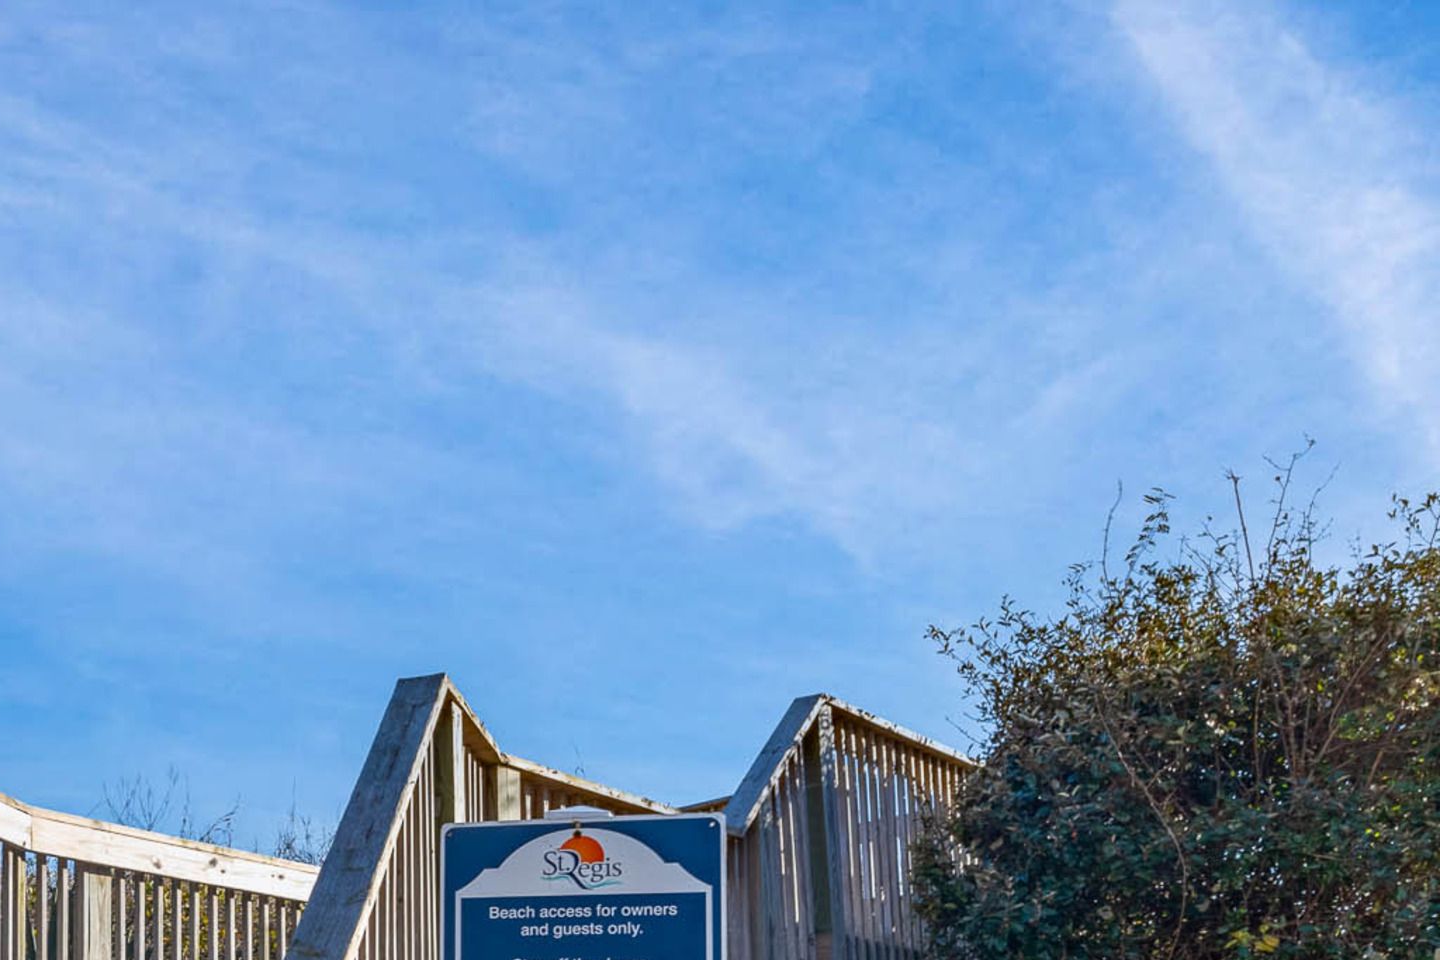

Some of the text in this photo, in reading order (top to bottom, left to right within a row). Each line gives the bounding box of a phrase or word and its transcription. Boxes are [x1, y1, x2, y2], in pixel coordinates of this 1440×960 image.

[489, 904, 678, 920] Beach access for owners
[520, 922, 644, 938] and guests only.
